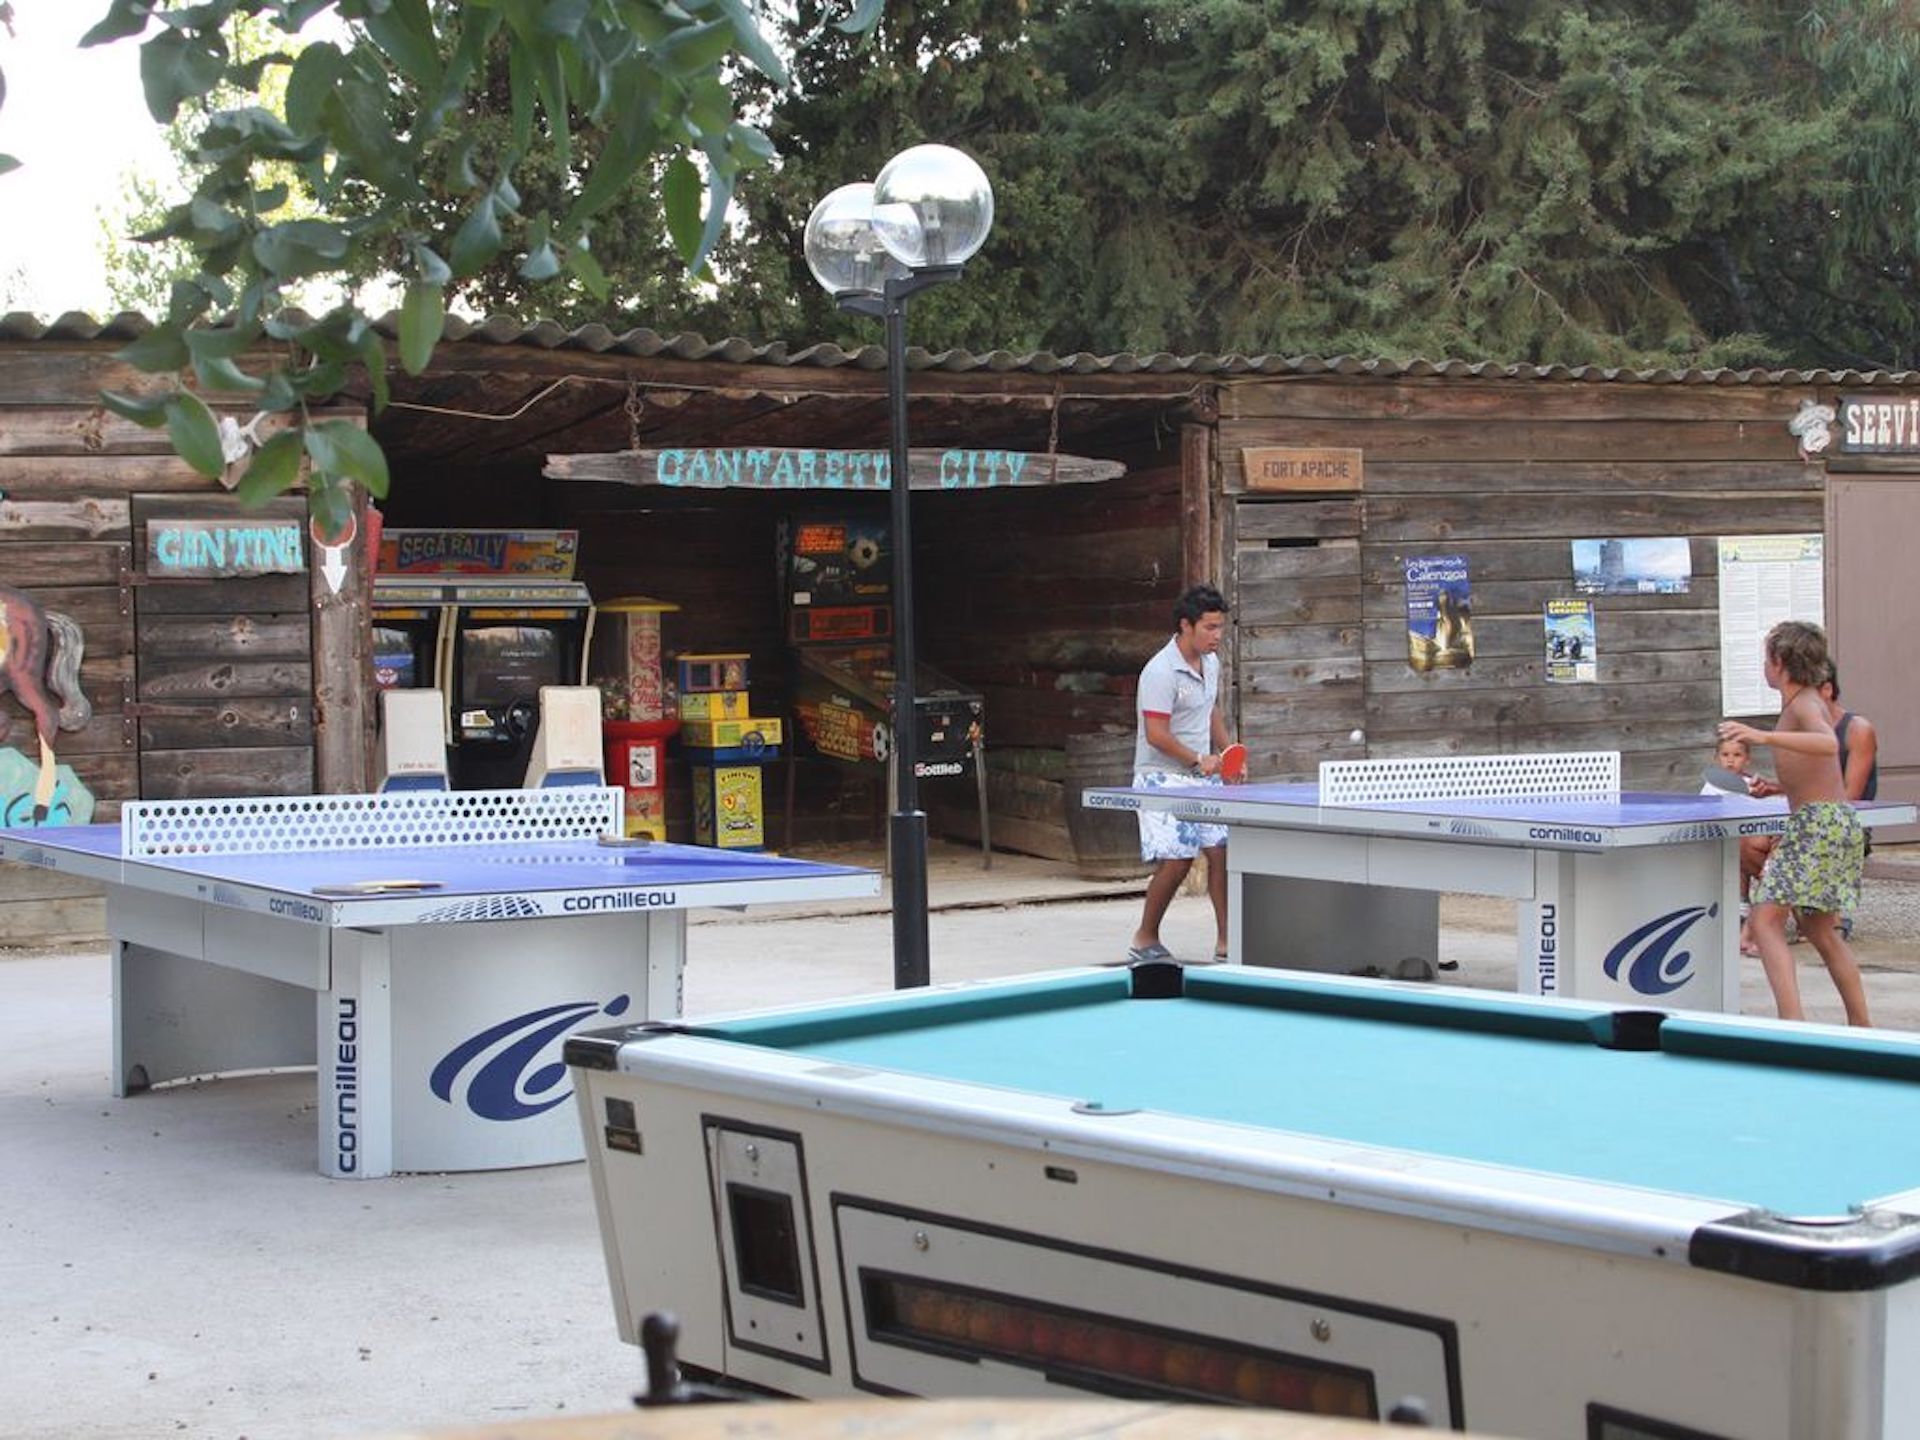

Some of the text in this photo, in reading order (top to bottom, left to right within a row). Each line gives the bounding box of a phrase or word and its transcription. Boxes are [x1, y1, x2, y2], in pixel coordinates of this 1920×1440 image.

[940, 449, 1024, 488] CITY
[1263, 461, 1349, 478] FORT APACHE
[401, 534, 504, 567] SEGA RALLY
[914, 763, 963, 776] Gottlieb
[1089, 795, 1140, 808] cornilleau
[1529, 827, 1602, 843] cornilleau
[269, 896, 323, 921] cornilleau
[563, 891, 676, 911] cornilleau
[1539, 904, 1556, 996] nilleau
[336, 998, 356, 1172] cornilleau
